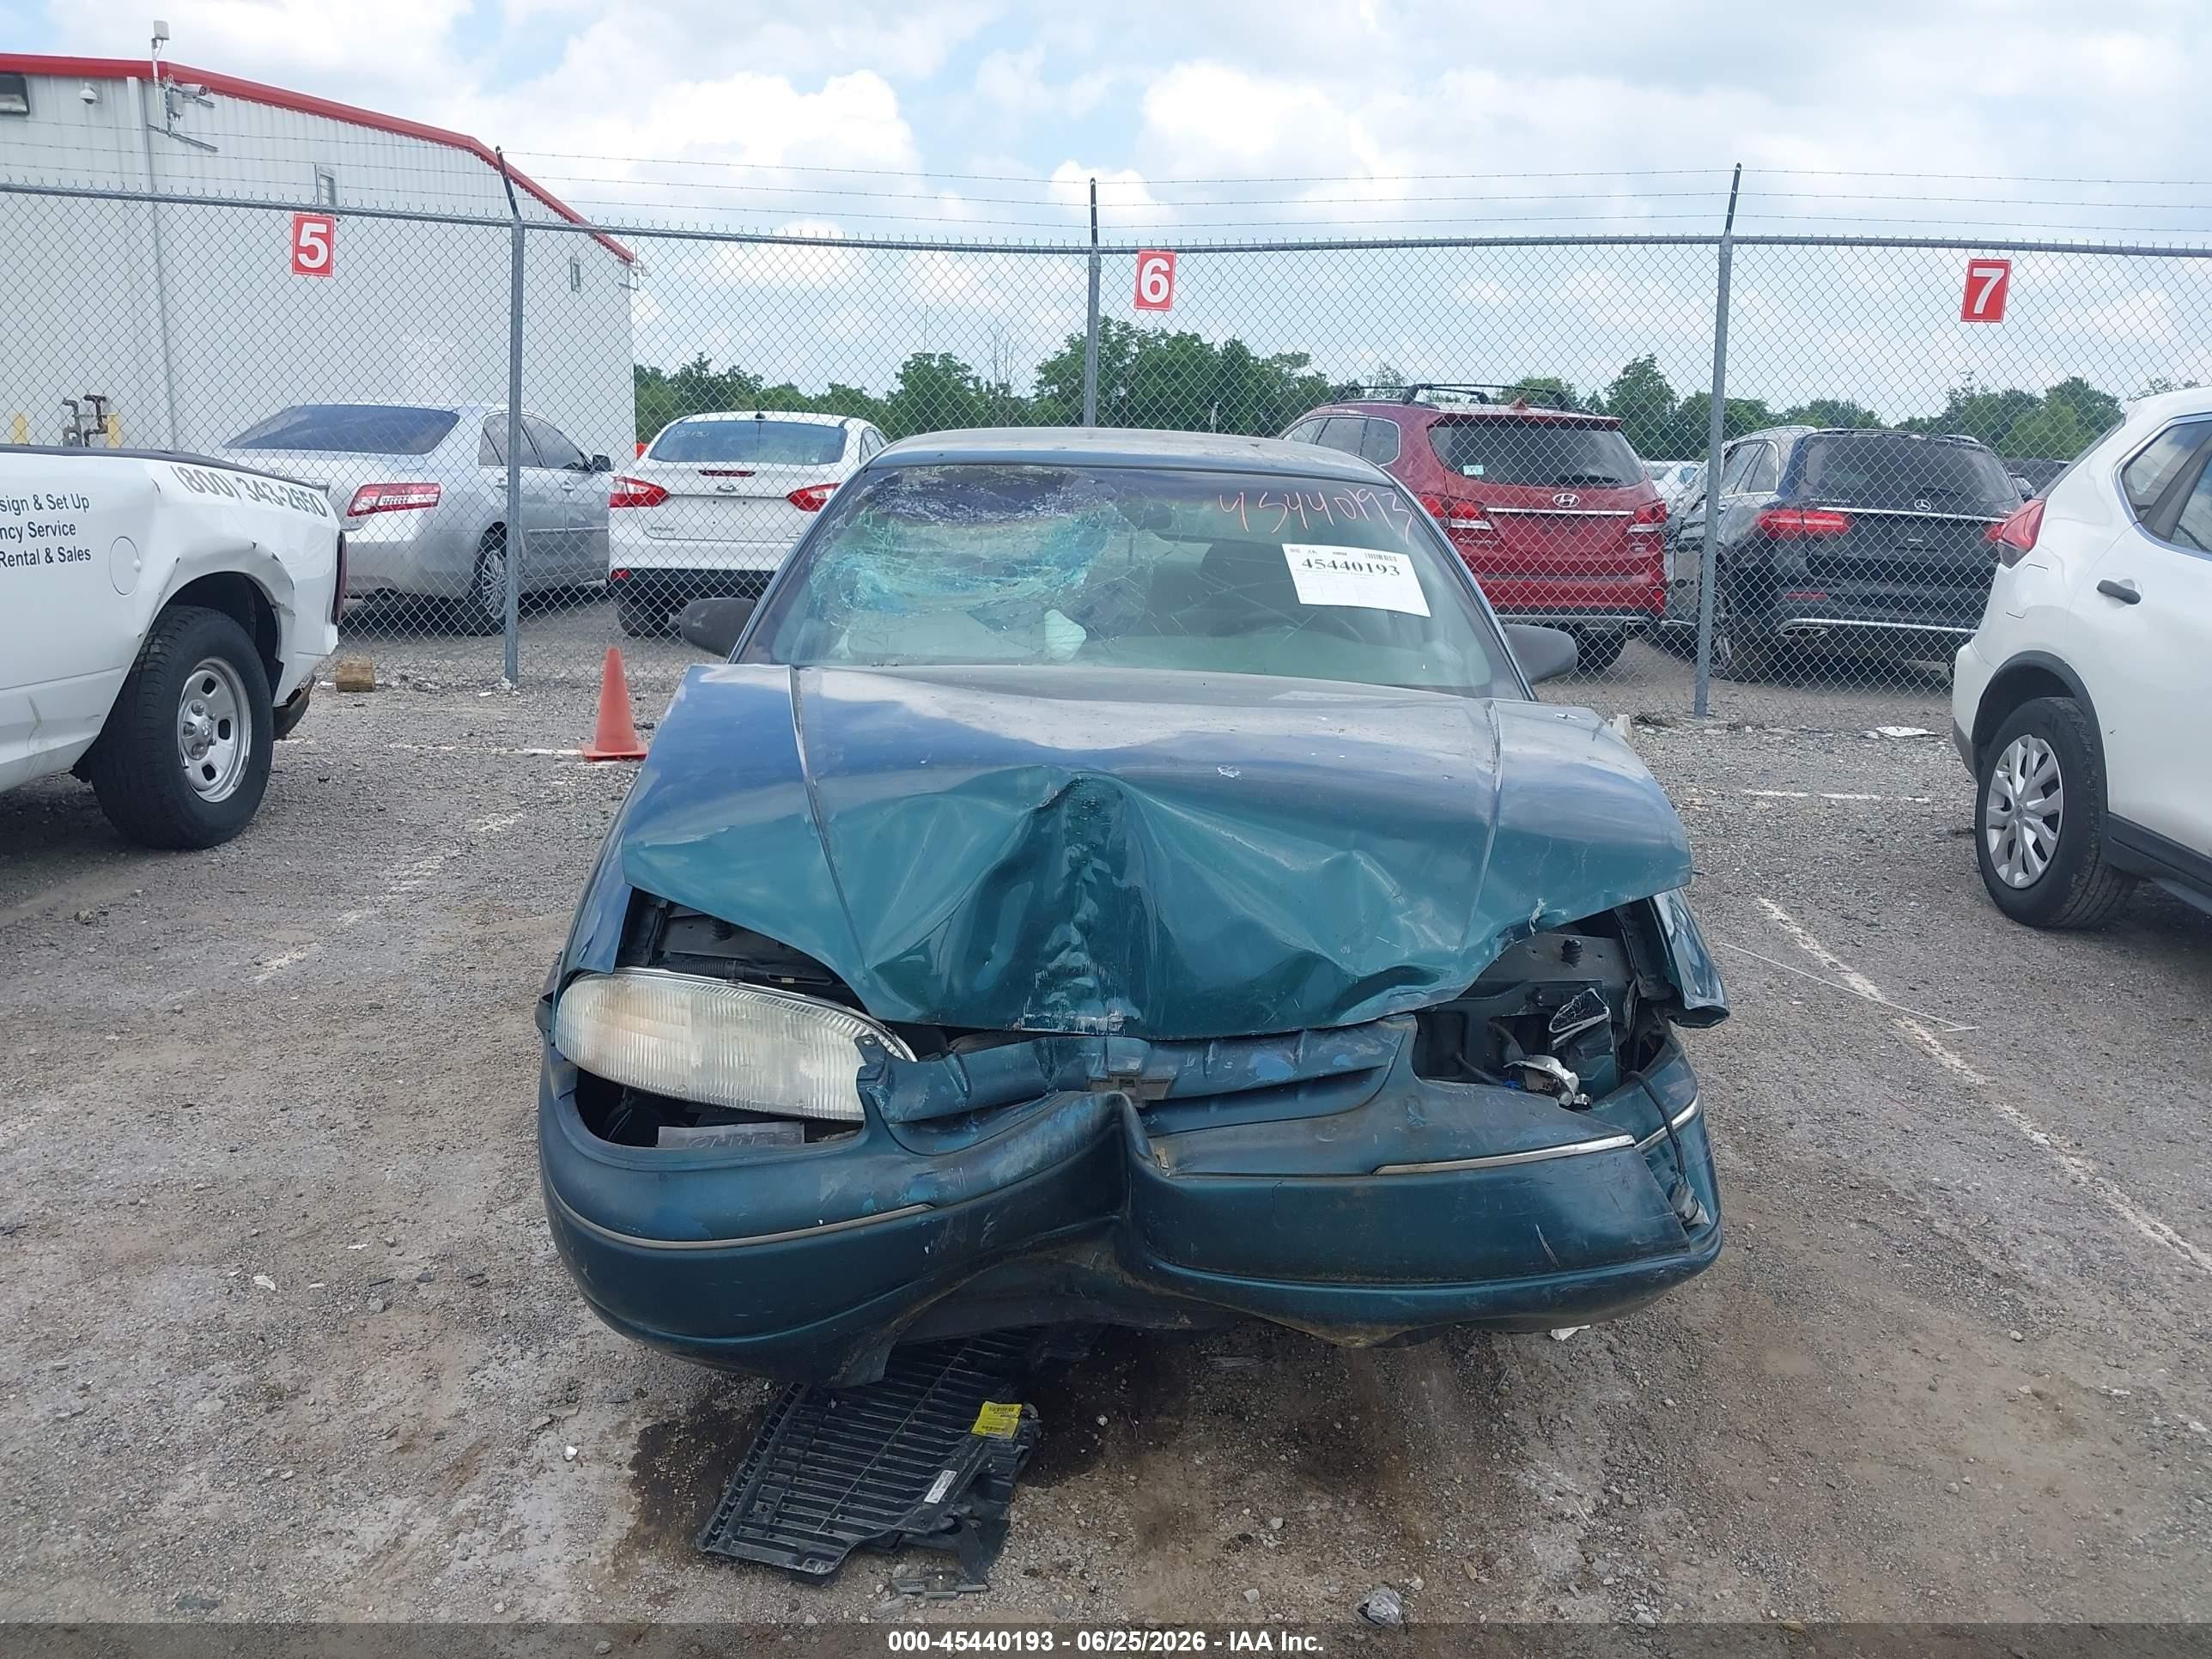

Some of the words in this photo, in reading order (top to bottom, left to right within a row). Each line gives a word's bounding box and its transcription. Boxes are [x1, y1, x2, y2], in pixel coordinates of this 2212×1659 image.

[297, 222, 328, 269] 5
[1140, 257, 1170, 304] 6
[1972, 267, 2006, 314] 7
[33, 494, 44, 511] &
[46, 493, 70, 510] Set
[70, 493, 90, 514] Up
[170, 465, 242, 500] (800)
[235, 476, 328, 518] 343-2650
[27, 520, 76, 538] Service
[1219, 487, 1413, 545] 45440193
[0, 548, 40, 568] Rental
[45, 547, 54, 564] &
[58, 545, 92, 563] Sales
[1302, 558, 1401, 577] 45440193
